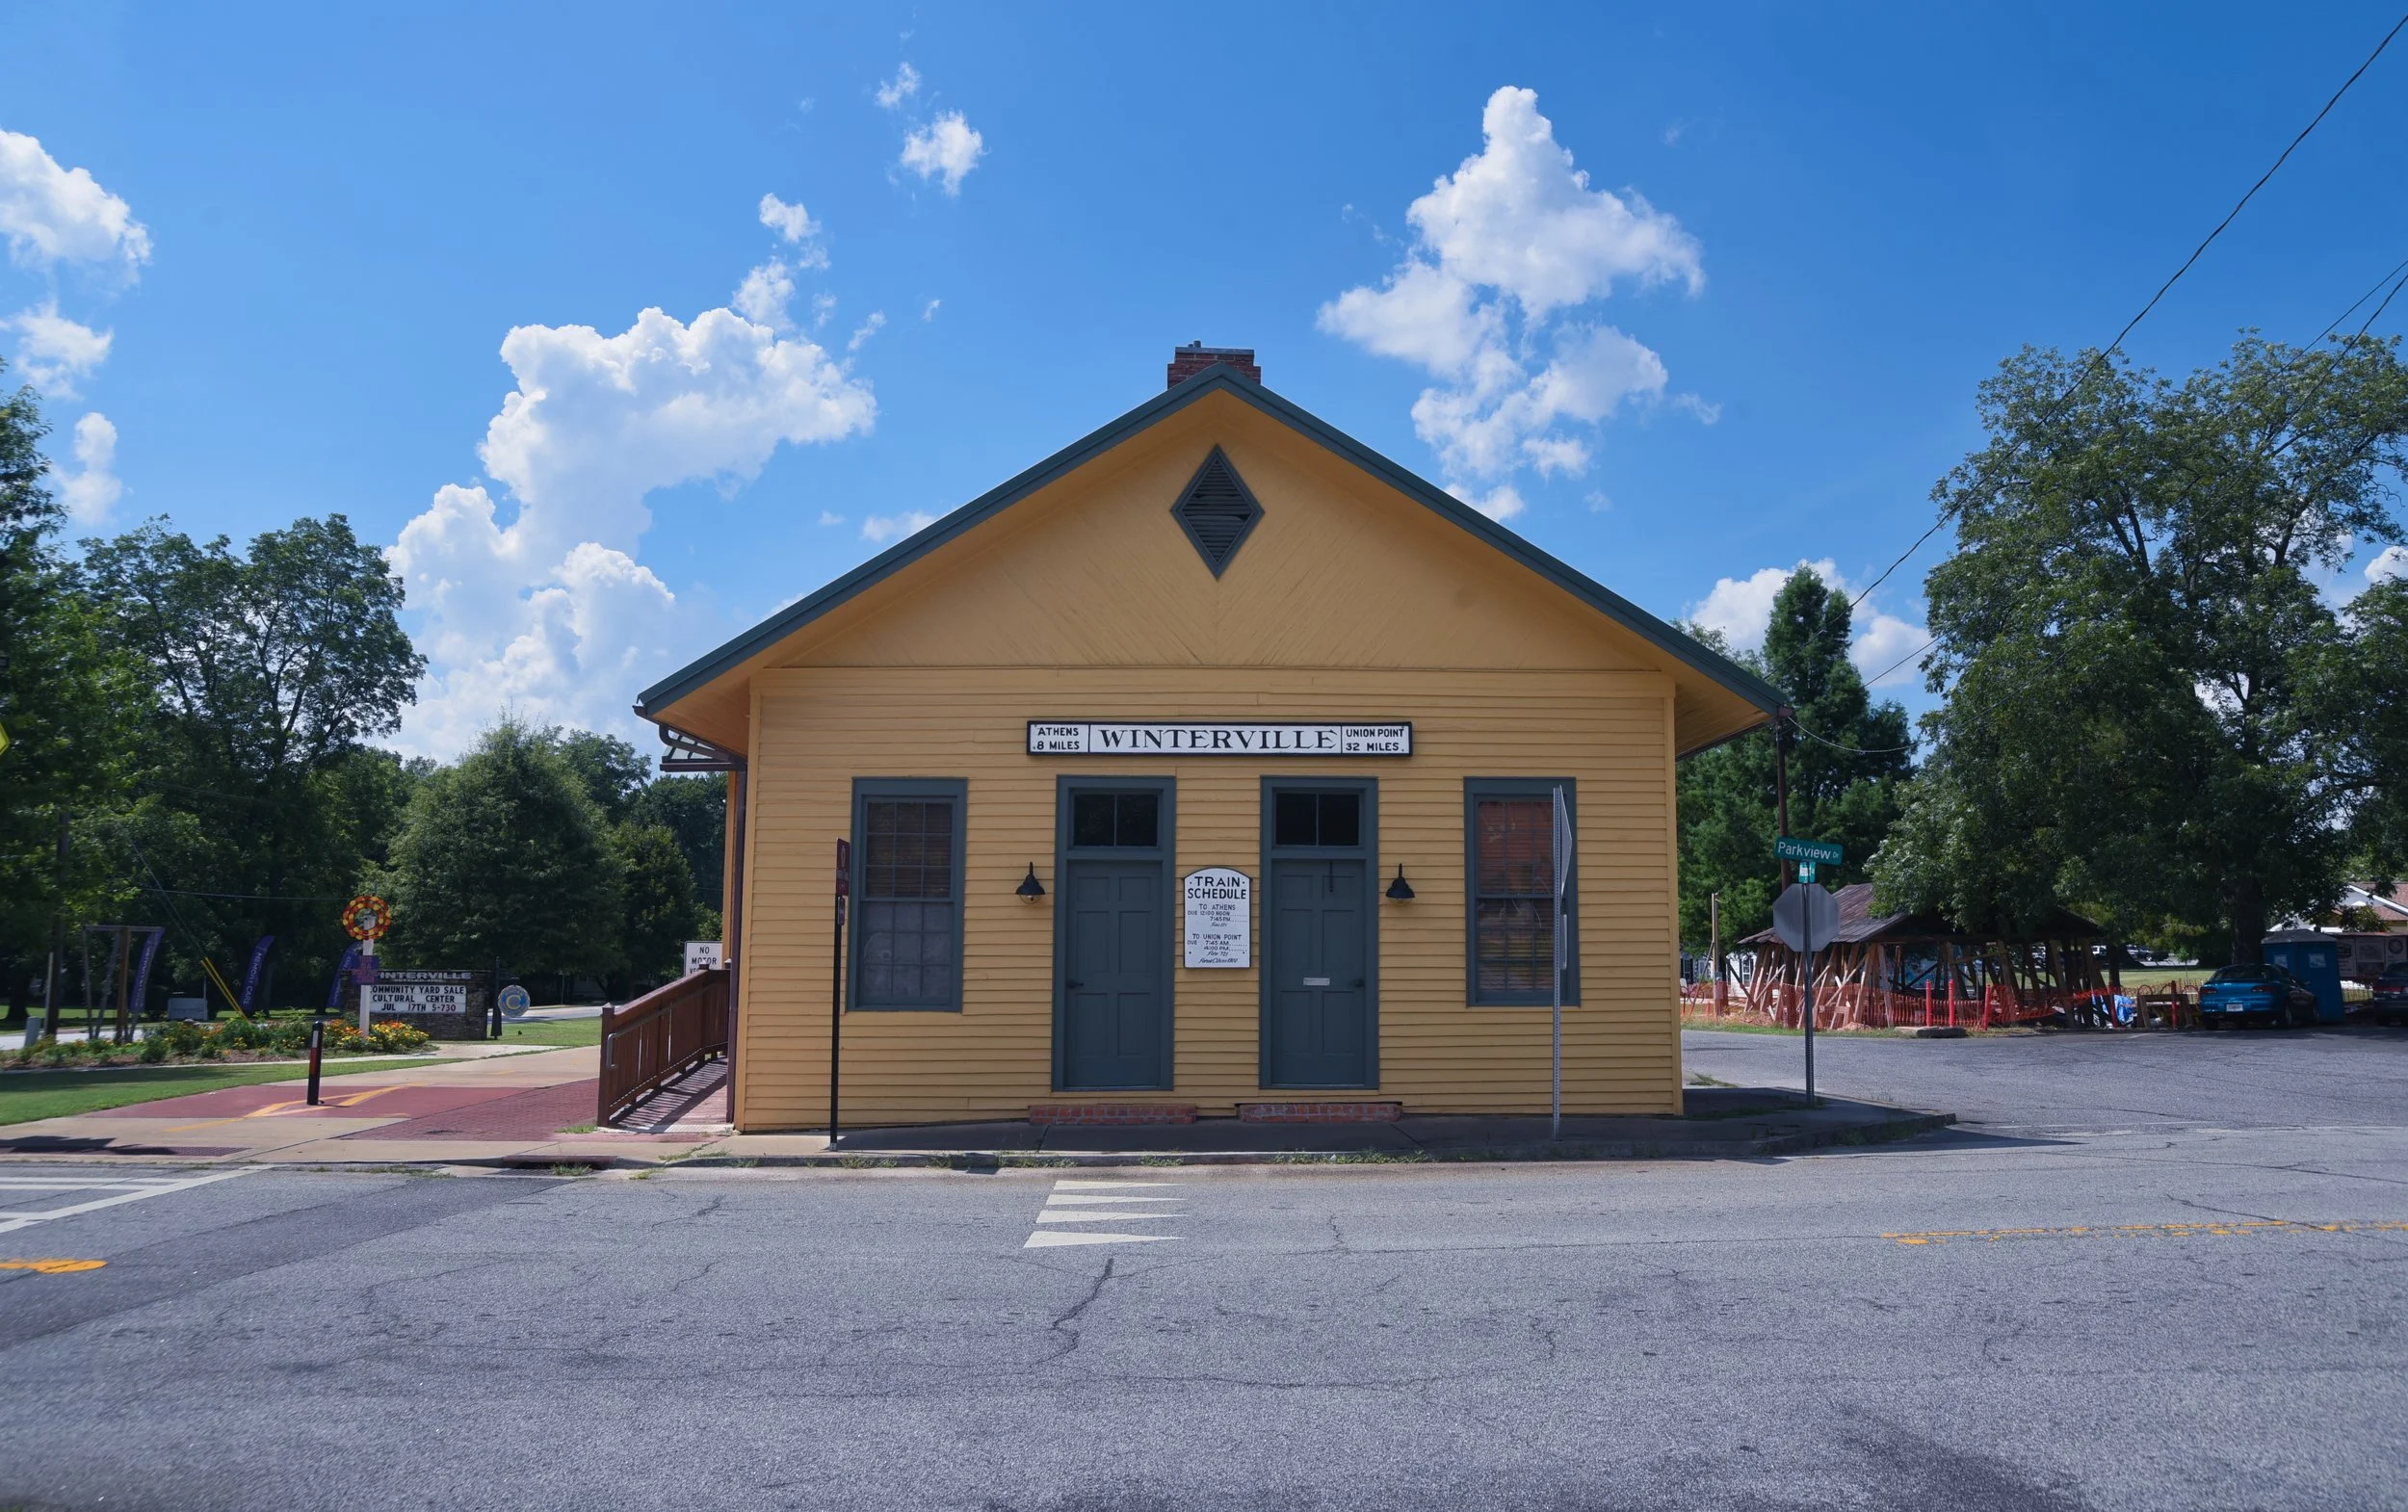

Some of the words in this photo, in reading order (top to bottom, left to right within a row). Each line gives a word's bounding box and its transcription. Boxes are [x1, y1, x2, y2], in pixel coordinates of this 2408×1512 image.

[1037, 727, 1079, 736] ATHENS
[1346, 728, 1375, 738] UNION
[1377, 728, 1404, 738] POINT
[1098, 729, 1336, 749] WINTERVILLE
[1049, 741, 1080, 750] MILES
[1345, 742, 1360, 751] 32
[1366, 742, 1400, 751] MILES
[1778, 841, 1831, 860] Parkview
[1832, 850, 1840, 859] Dr
[1194, 876, 1241, 887] TRAIN
[1187, 888, 1246, 899] SCHEDULE
[699, 946, 710, 954] NO
[370, 985, 415, 994] OMMUNITY
[419, 985, 440, 994] YARD
[372, 994, 415, 1003] CULTURAL
[425, 995, 455, 1004] CENTER
[432, 1004, 457, 1012] 5-730
